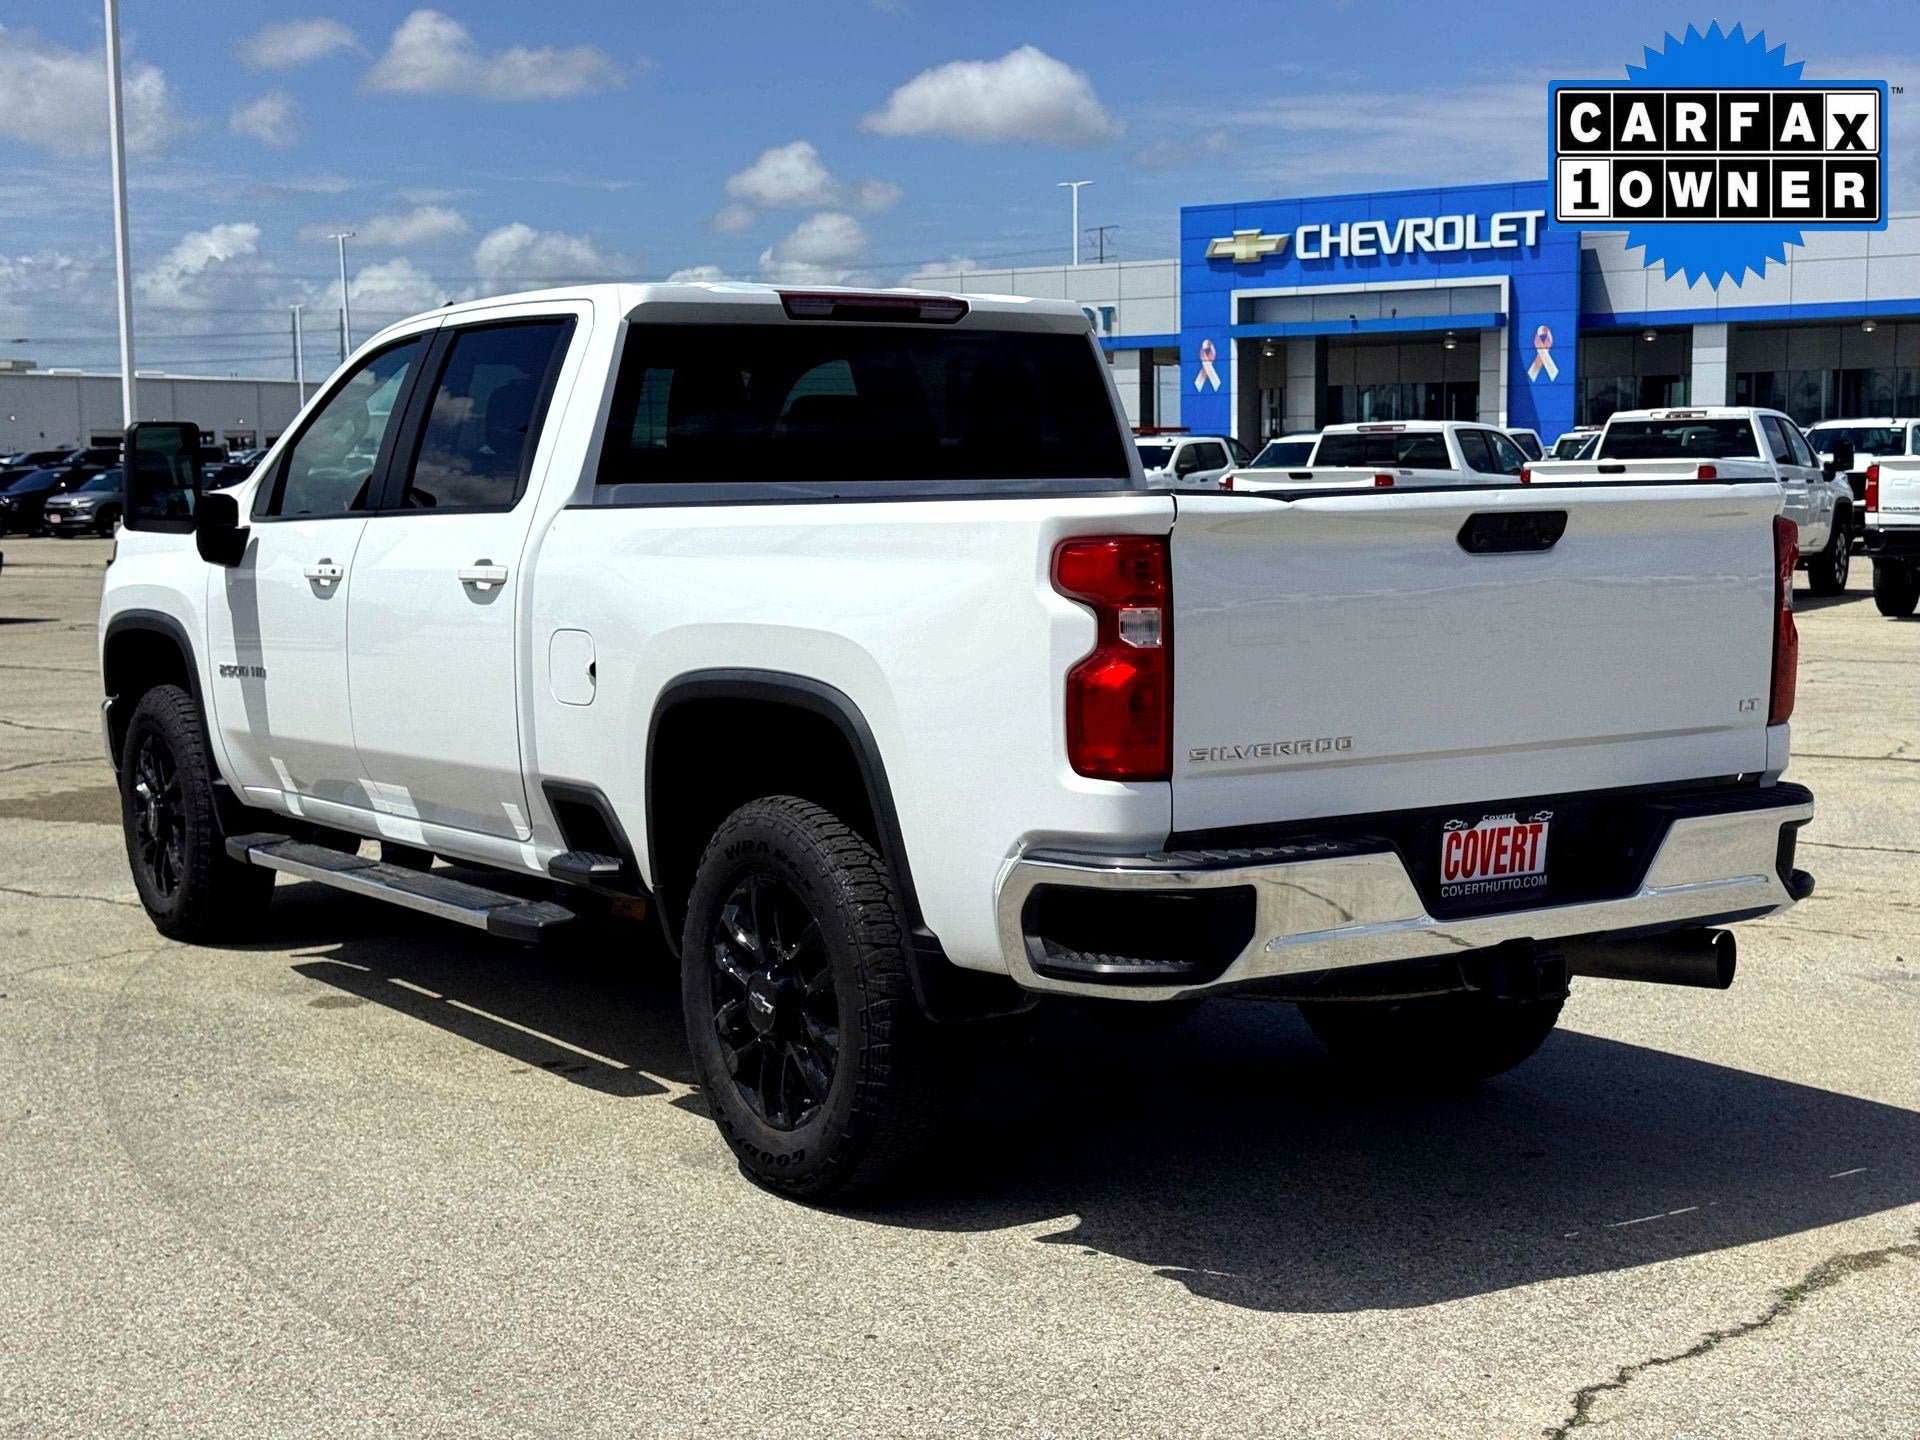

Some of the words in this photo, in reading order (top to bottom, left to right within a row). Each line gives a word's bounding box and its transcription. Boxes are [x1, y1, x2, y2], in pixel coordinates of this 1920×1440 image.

[1295, 209, 1546, 261] CHEVROLET
[1188, 735, 1353, 763] SILVERADO
[1482, 812, 1516, 821] Covert
[1444, 823, 1543, 881] COVERT
[1441, 875, 1547, 898] COVERTHUTTO.COM
